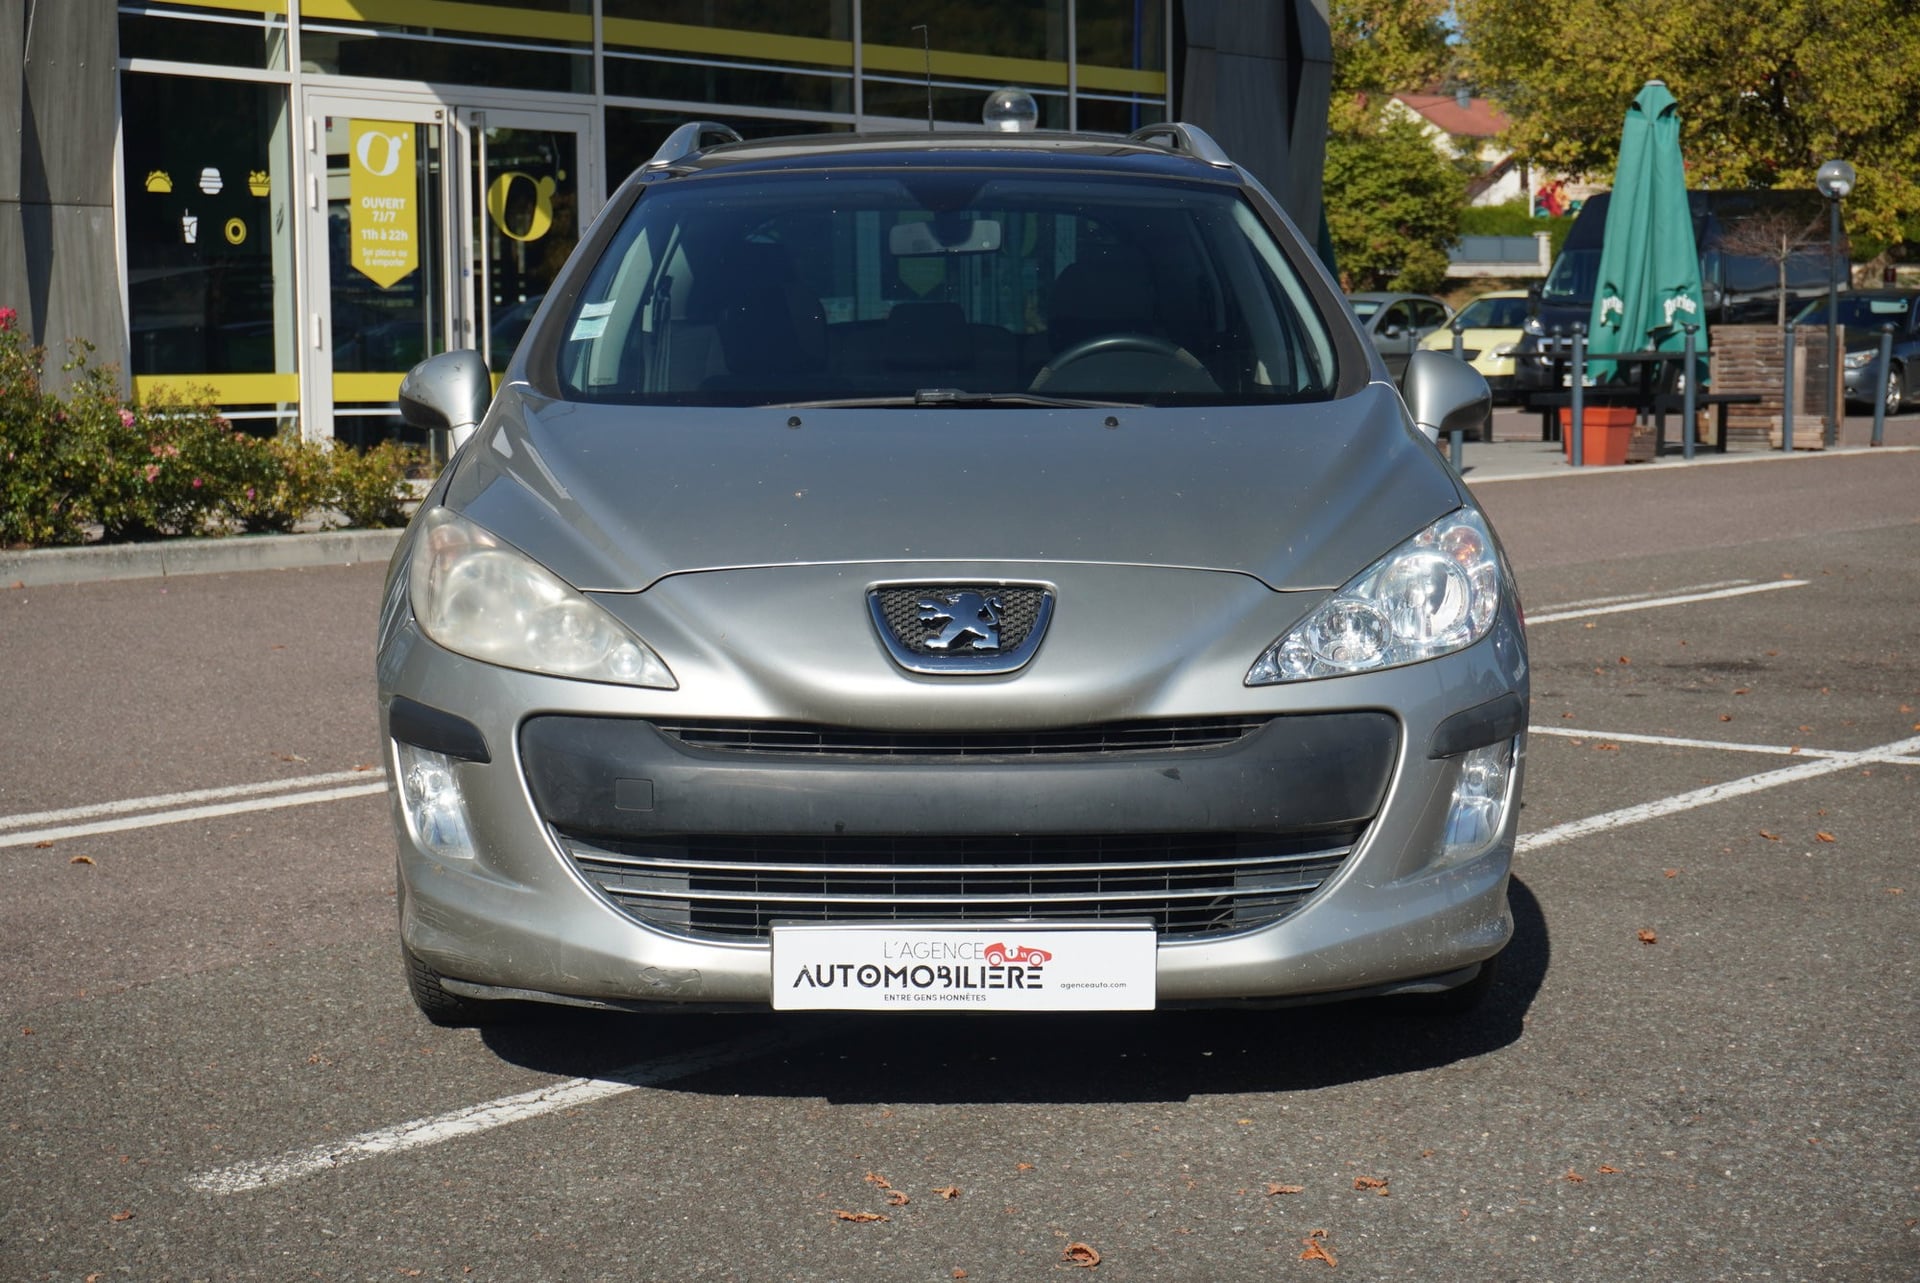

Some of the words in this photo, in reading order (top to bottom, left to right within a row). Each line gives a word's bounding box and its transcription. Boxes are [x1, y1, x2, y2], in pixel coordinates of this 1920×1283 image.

[362, 196, 406, 210] OUVERT
[361, 228, 378, 240] 11h
[380, 227, 388, 241] à
[389, 229, 409, 241] 22h
[1008, 948, 1014, 957] 1
[1060, 982, 1127, 990] agenceauto.com
[884, 993, 912, 1001] ENTRE
[913, 993, 937, 1001] GENS
[939, 992, 987, 1002] HONNÊTES
